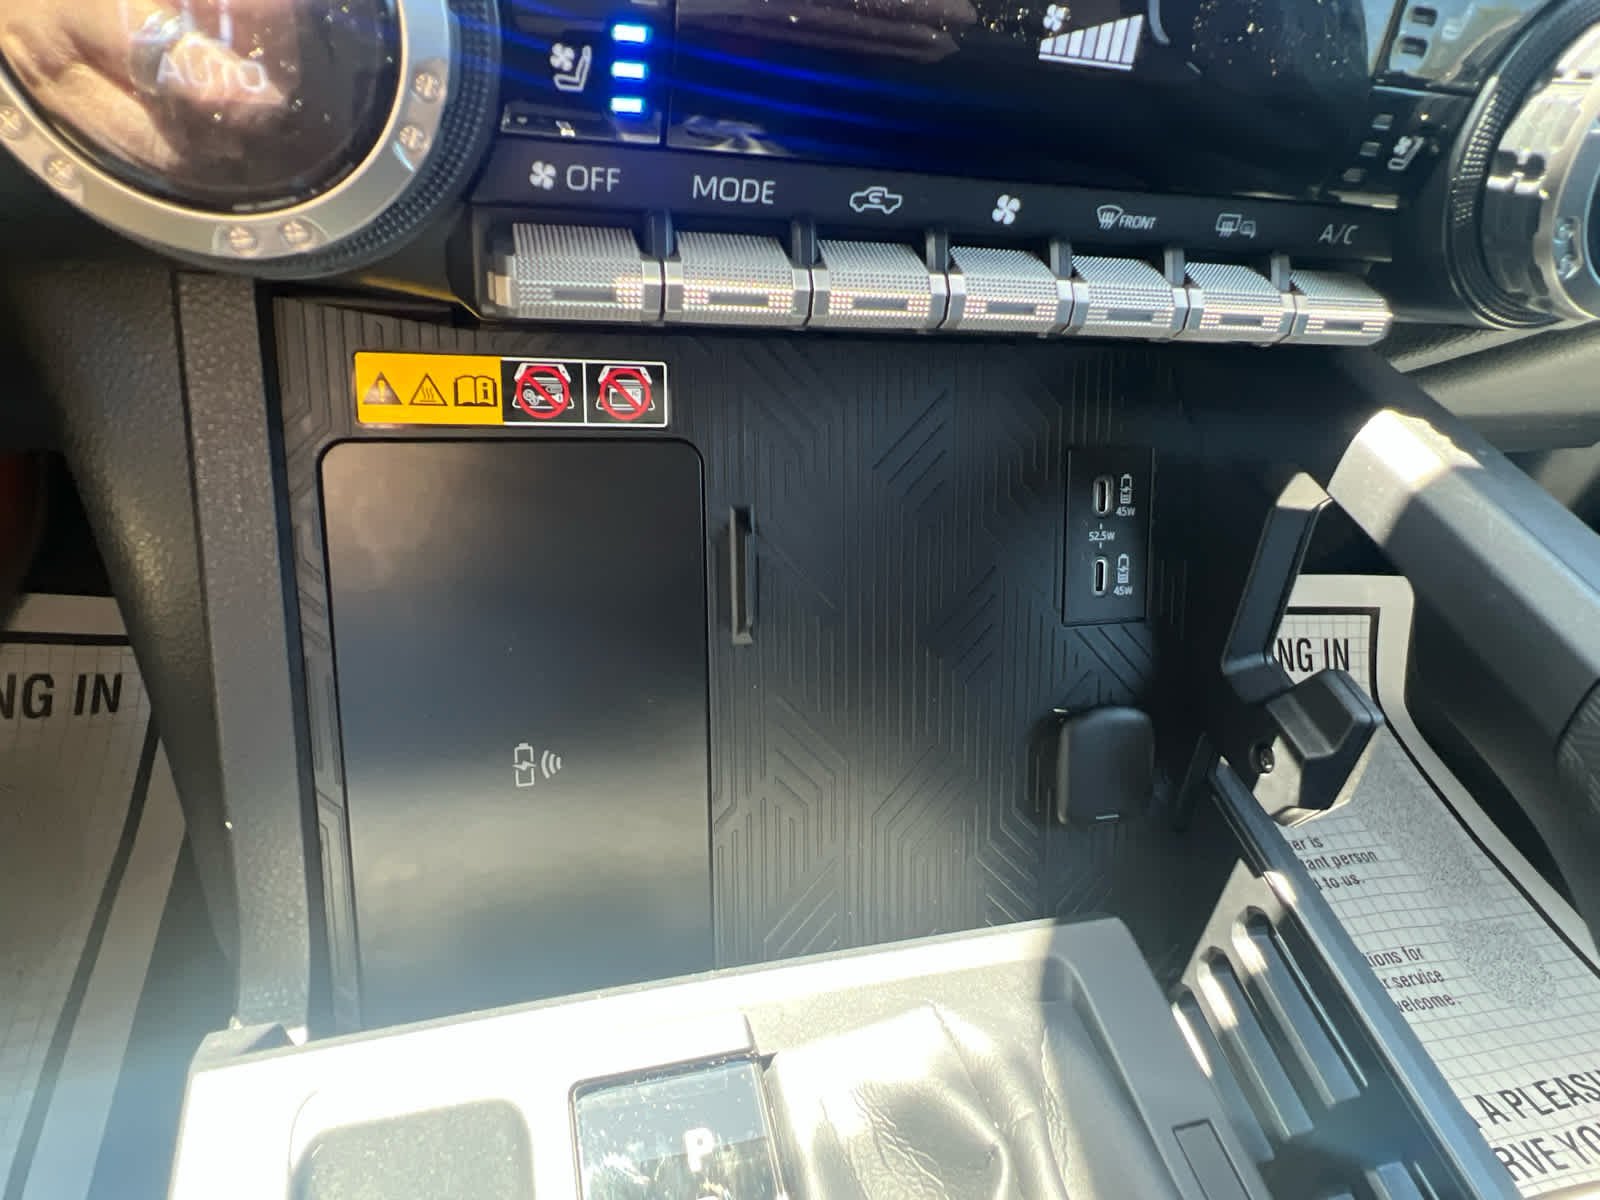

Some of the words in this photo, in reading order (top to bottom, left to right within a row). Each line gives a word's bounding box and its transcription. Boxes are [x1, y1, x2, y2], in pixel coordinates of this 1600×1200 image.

[156, 51, 268, 93] AUTO
[566, 164, 621, 193] OFF
[692, 174, 776, 205] MODE
[1118, 214, 1157, 230] FRONT
[1318, 223, 1358, 245] A/C
[1115, 506, 1136, 518] 45W
[1088, 530, 1116, 542] 52.5W
[1112, 585, 1133, 596] 45W
[1323, 637, 1350, 673] IN
[73, 672, 123, 716] IN
[1307, 836, 1324, 849] is
[1305, 855, 1331, 871] ant
[1330, 850, 1378, 869] person
[1321, 876, 1341, 889] to
[1400, 945, 1425, 961] for
[1391, 967, 1445, 989] service
[1473, 1093, 1512, 1125] A
